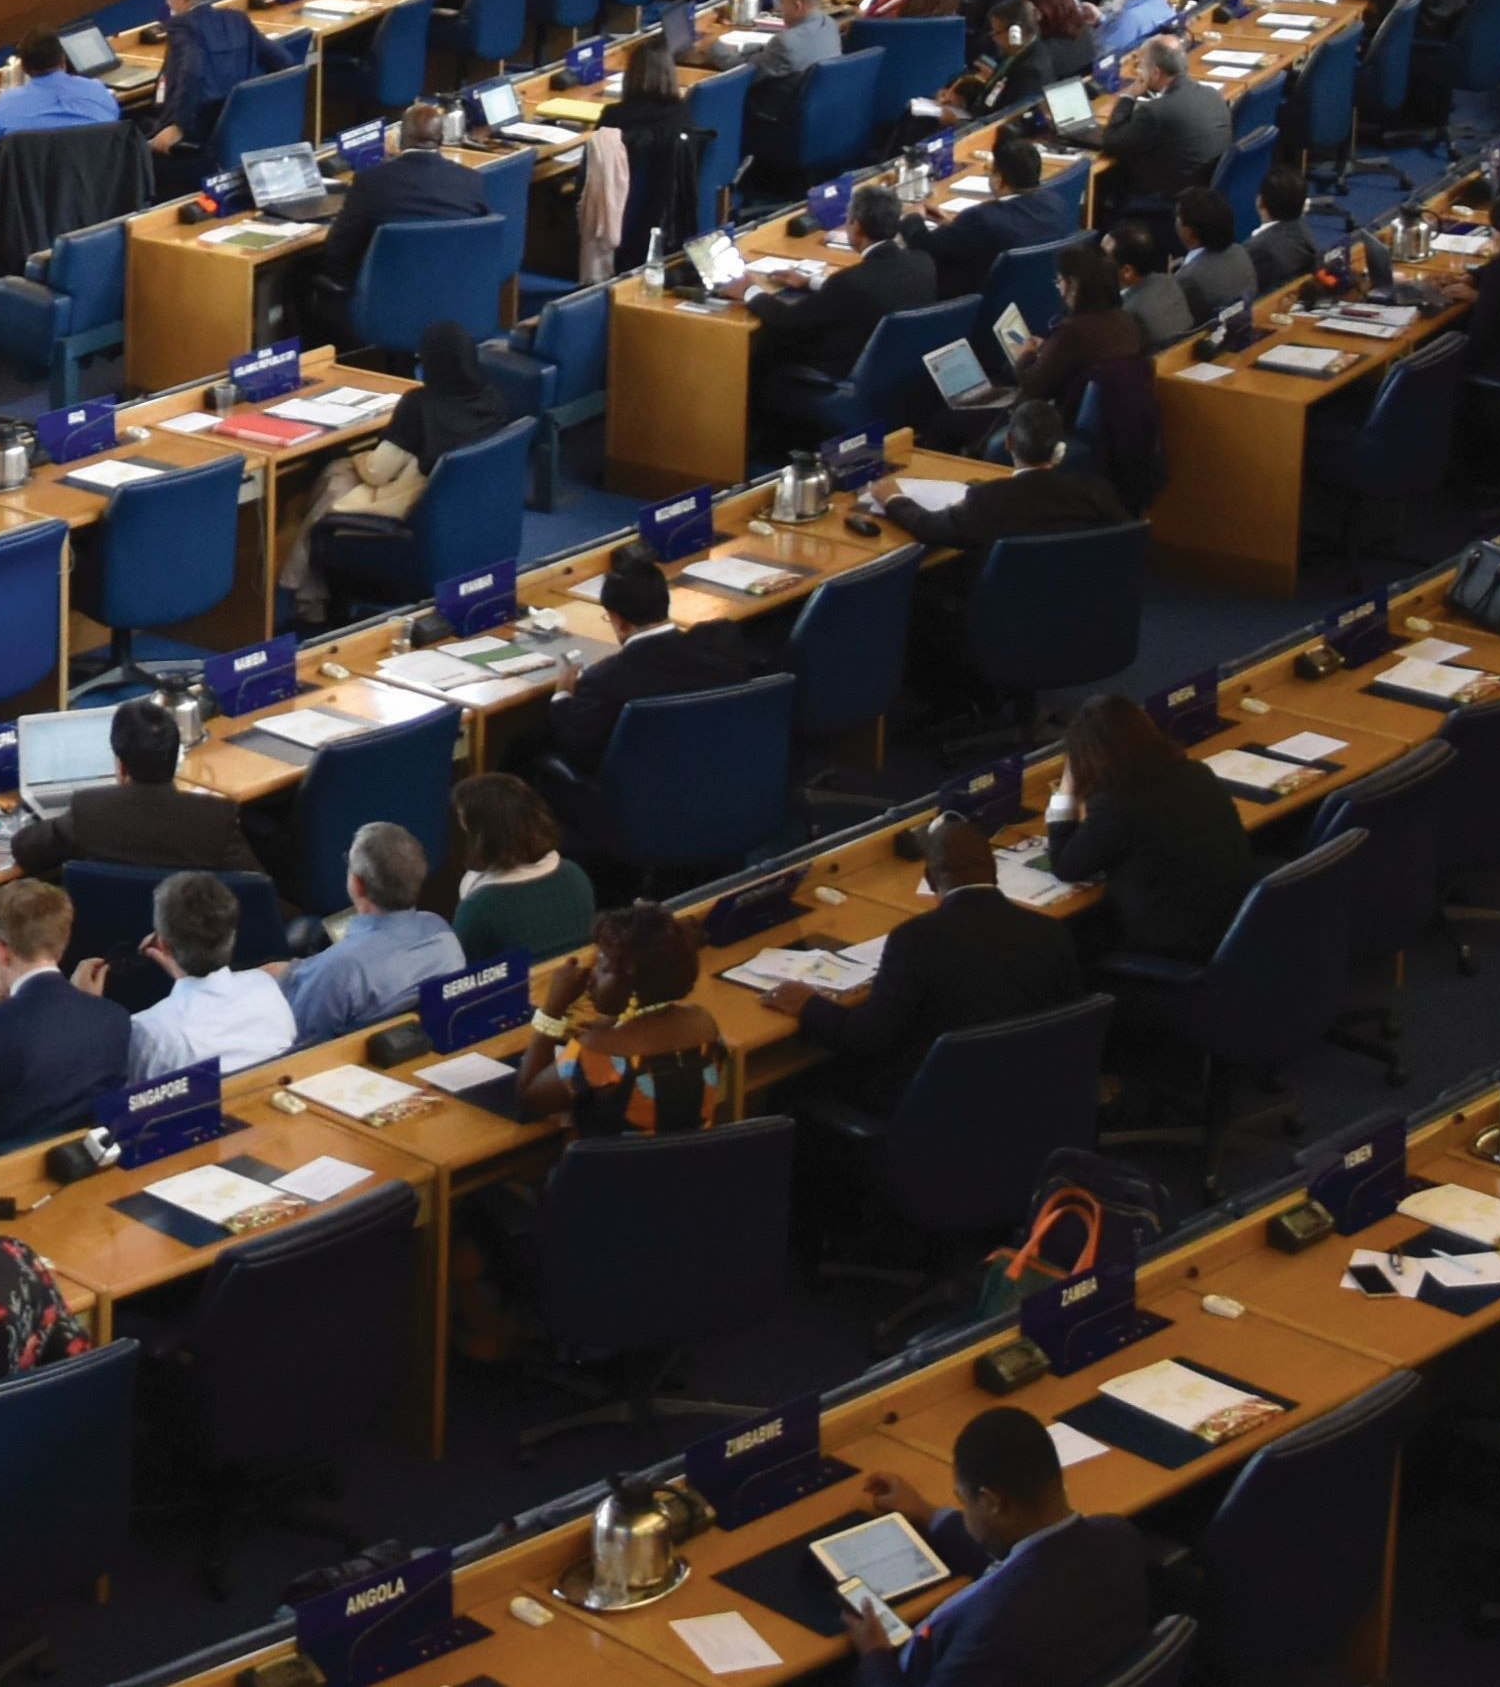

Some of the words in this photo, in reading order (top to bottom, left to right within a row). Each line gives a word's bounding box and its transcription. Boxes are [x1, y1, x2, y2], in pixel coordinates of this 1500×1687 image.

[443, 973, 476, 1000] SIERRA
[477, 961, 508, 987] LEONE
[128, 1076, 189, 1112] SINGAPORE
[1061, 1276, 1098, 1306] ZAMBIA
[725, 1417, 784, 1459] ZIMBABWE
[345, 1576, 406, 1617] ANGOLA
